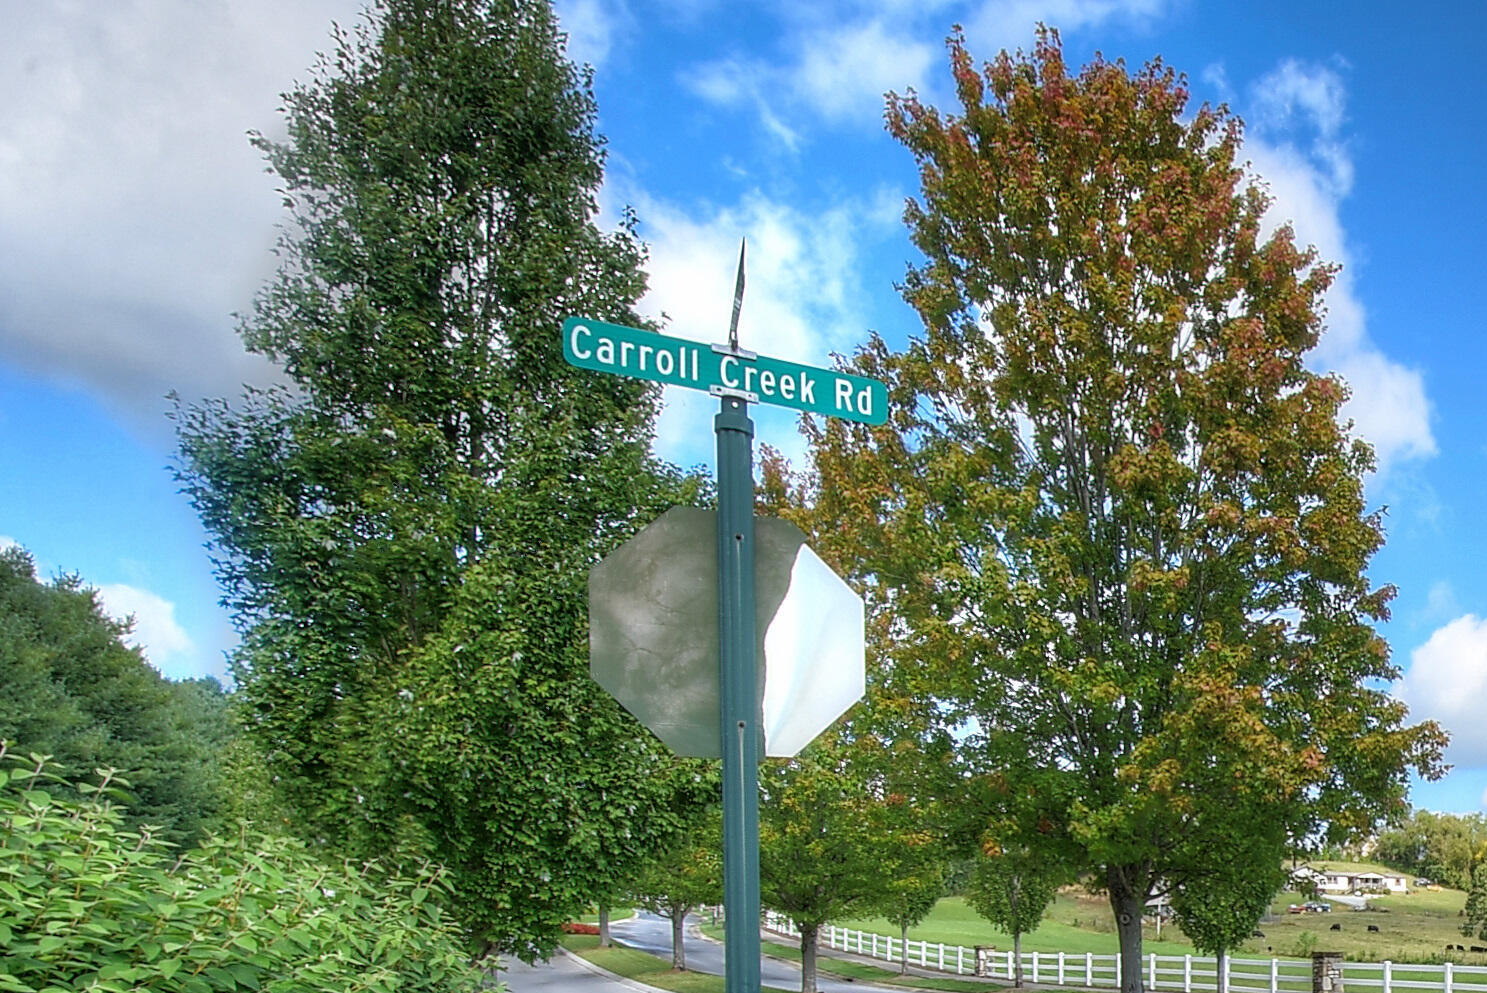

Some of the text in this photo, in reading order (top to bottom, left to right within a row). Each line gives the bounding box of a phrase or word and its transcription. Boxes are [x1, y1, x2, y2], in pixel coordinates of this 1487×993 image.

[570, 324, 872, 416] Carroll Creek Rd
